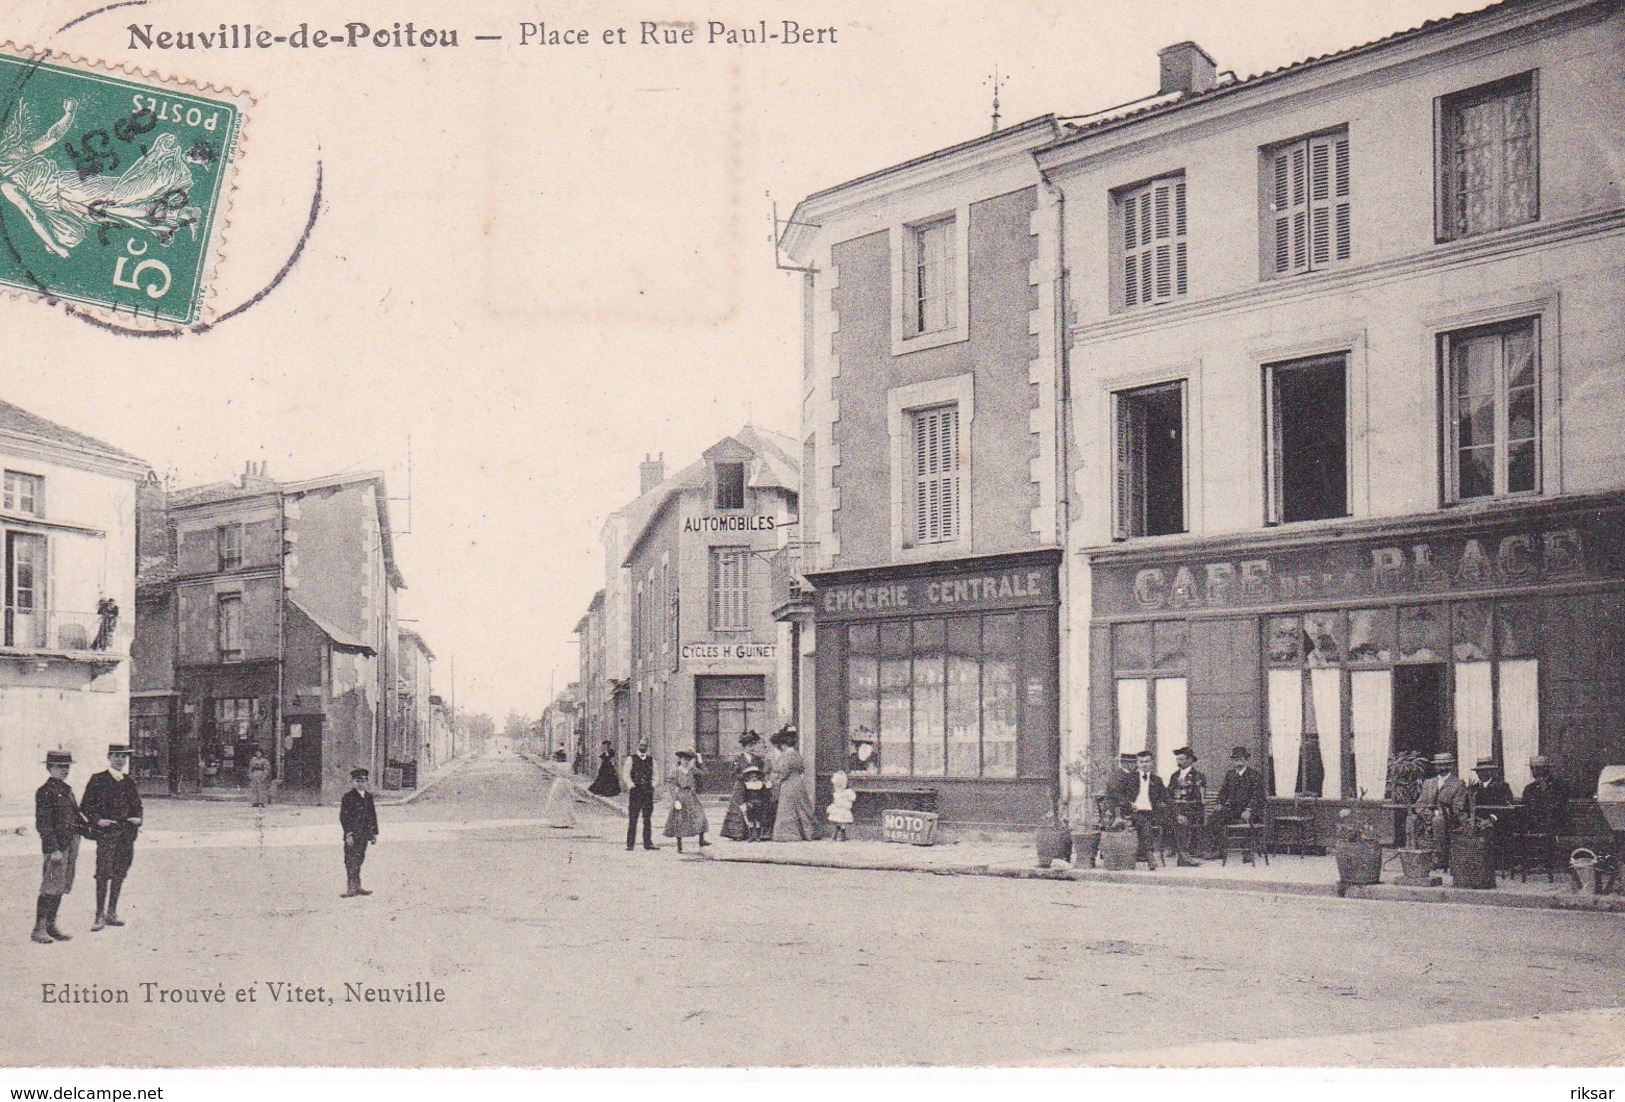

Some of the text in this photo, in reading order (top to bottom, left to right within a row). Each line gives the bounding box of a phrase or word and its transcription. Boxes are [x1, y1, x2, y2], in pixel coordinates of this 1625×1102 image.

[132, 94, 218, 131] POSTES
[683, 516, 775, 533] AUTOMOBILES
[1371, 529, 1584, 588] PLACE
[824, 572, 1042, 613] EPICERIE CENTRALE
[681, 645, 719, 659] CYCLES
[736, 645, 777, 659] GUINET
[884, 814, 923, 832] MOTO
